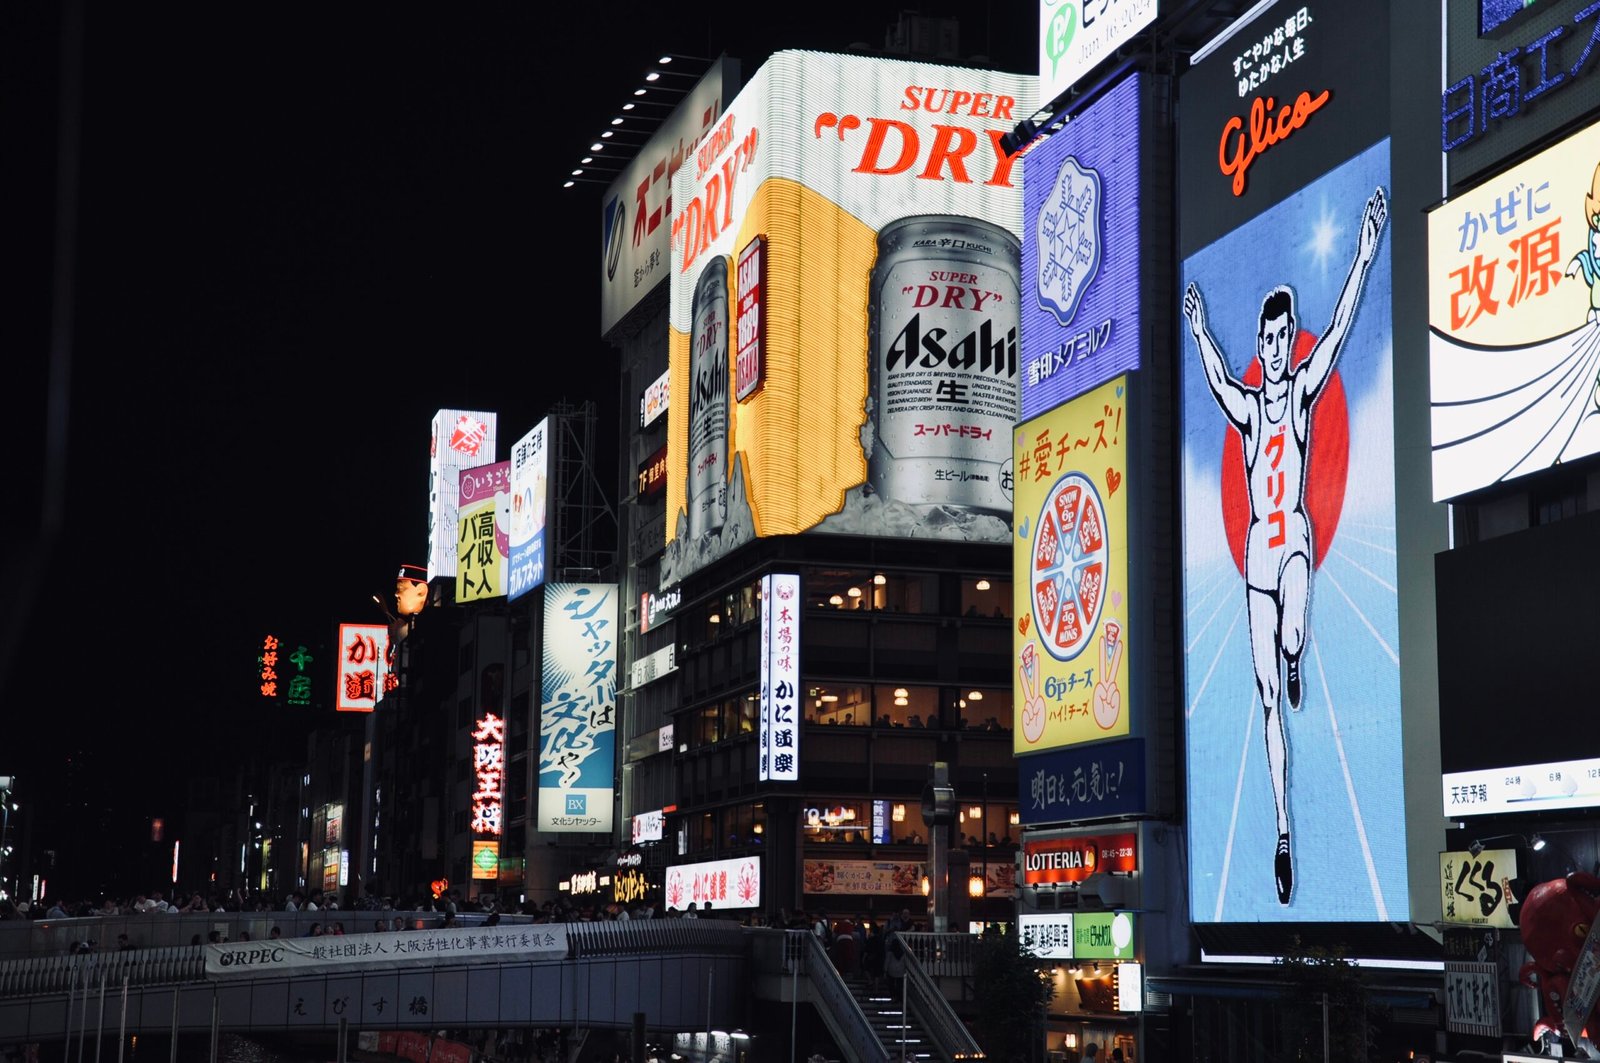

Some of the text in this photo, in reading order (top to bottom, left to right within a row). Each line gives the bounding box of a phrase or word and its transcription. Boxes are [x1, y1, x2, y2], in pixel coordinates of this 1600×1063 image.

[1233, 7, 1313, 77] すこやかな毎日、
[1238, 41, 1305, 97] ゆたかな人生
[900, 84, 1017, 121] SUPER
[696, 113, 736, 182] SUPER
[1218, 89, 1333, 197] Glico
[1458, 181, 1551, 254] かぜに
[929, 271, 978, 285] SUPER
[1448, 216, 1563, 331] 改源
[886, 313, 1016, 379] Asahi
[1027, 318, 1112, 388] 雪印メグミルク
[936, 380, 969, 404] 生
[973, 374, 999, 384] PRECISION
[914, 424, 992, 441] スーパードライ
[1264, 425, 1286, 549] グリコ
[461, 514, 479, 598] バイト
[260, 634, 279, 697] お好み焼
[777, 606, 793, 672] 本場の味
[470, 712, 504, 834] 大阪王将
[1451, 784, 1488, 804] 天気予報
[567, 799, 584, 812] BX
[1026, 850, 1082, 871] LOTTERIA
[1455, 860, 1503, 917] くくる
[298, 943, 388, 960] 一般社団法人
[393, 932, 556, 954] 大阪活性化事業実行委員会
[293, 995, 428, 1017] えびす橋
